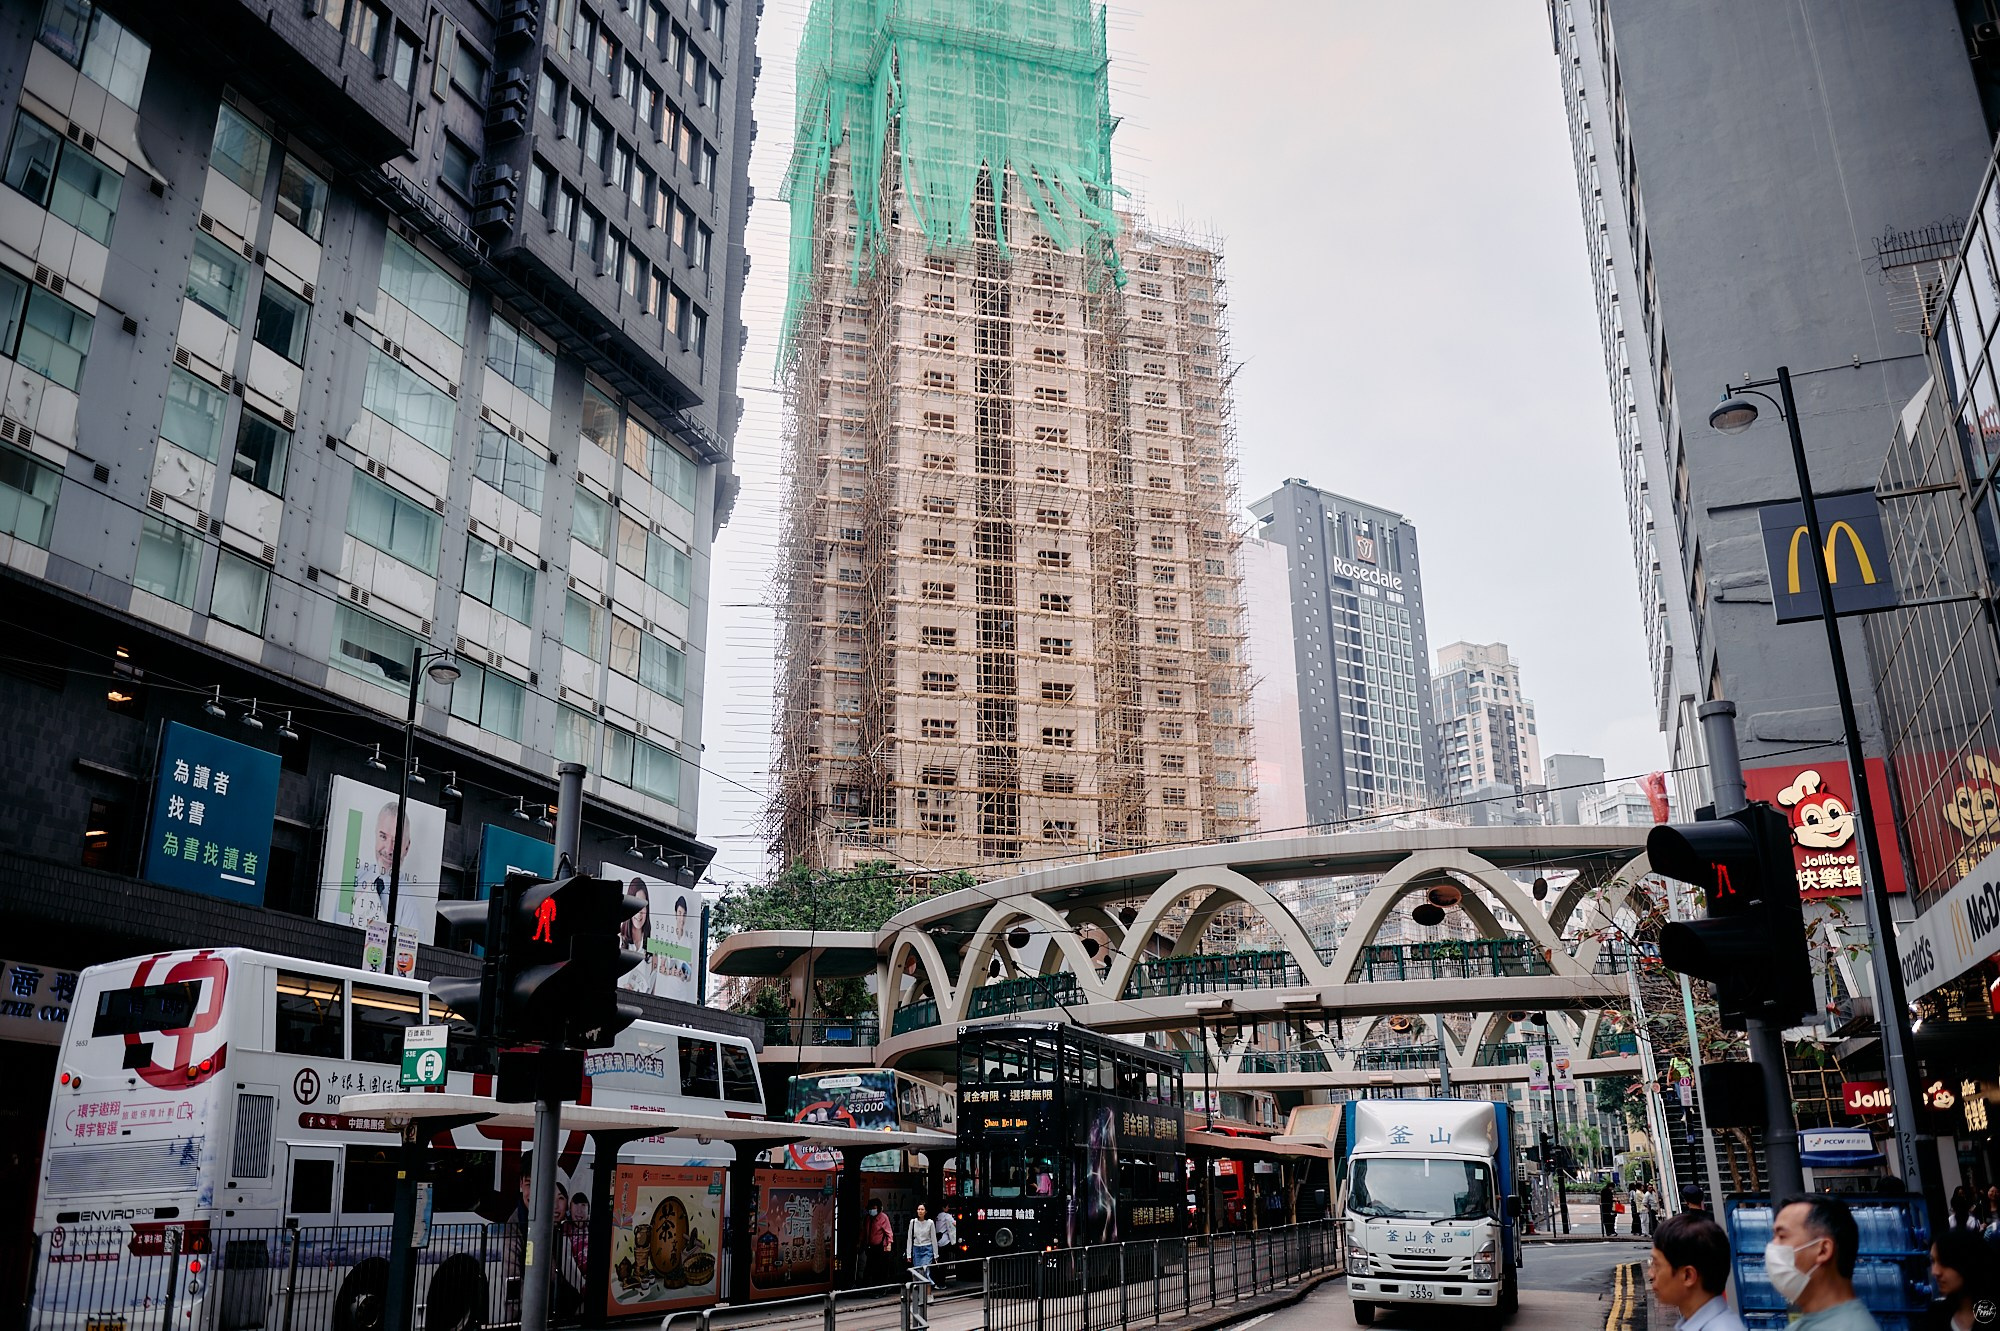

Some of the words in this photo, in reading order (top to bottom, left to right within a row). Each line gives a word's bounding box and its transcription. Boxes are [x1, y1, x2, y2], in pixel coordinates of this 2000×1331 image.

[1333, 556, 1403, 591] Rosedale
[173, 759, 229, 795] 為讀者
[168, 795, 206, 825] 找書
[162, 832, 258, 875] 為書找讀者
[1802, 853, 1855, 868] Jollibee
[355, 858, 418, 884] BRIDGNG
[959, 1026, 967, 1034] 52
[1047, 1022, 1059, 1031] 52
[963, 1091, 1000, 1103] 資金有限
[1009, 1089, 1053, 1101] 選擇無限
[77, 1101, 121, 1118] 環宇遨翔
[848, 1102, 884, 1114] $3,000
[74, 1121, 119, 1138] 環宇智選
[348, 1117, 386, 1131] 中銀集團保
[984, 1118, 999, 1128] Shau
[1388, 1125, 1451, 1145] 釜山
[1386, 1229, 1453, 1244] 釜山食品
[1404, 1246, 1436, 1254] ISUZU
[1410, 1290, 1433, 1299] 3539
[1415, 1283, 1427, 1291] YA
